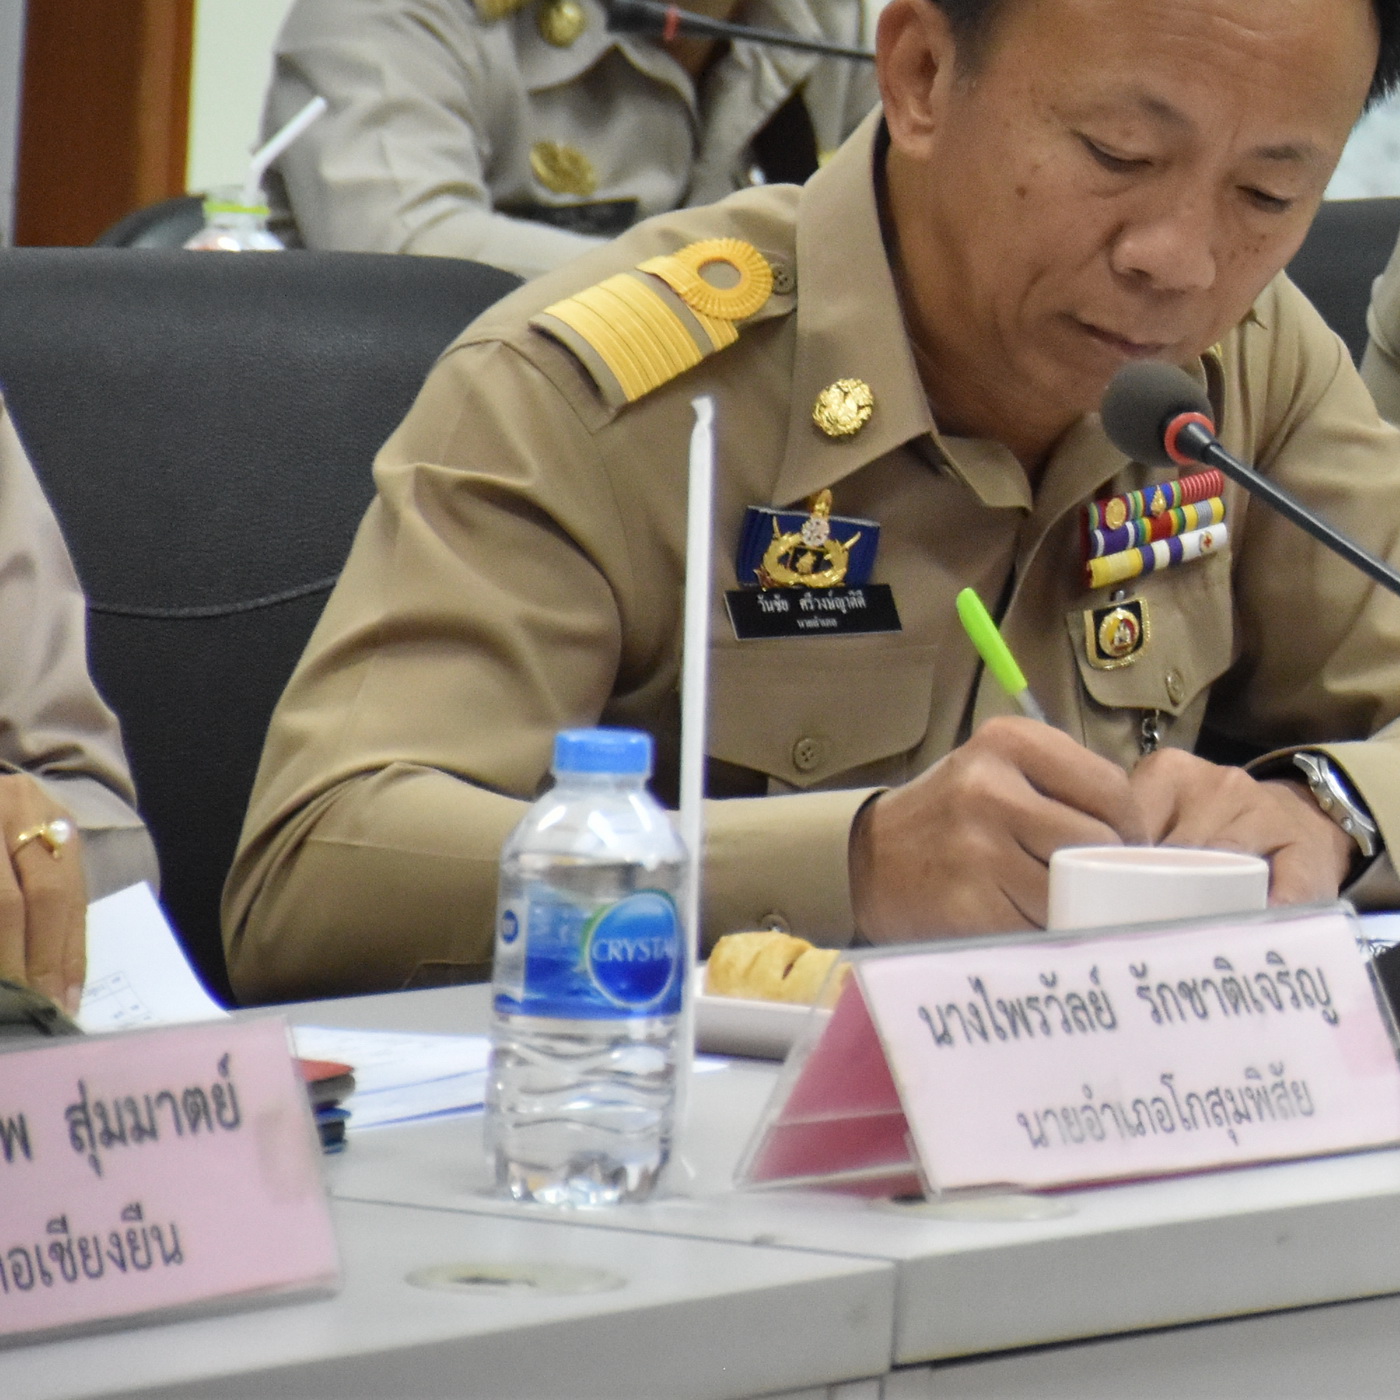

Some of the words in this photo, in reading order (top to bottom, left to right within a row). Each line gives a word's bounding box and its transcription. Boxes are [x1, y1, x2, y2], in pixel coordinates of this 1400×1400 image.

[918, 964, 1118, 1046] นางไพรวัลย์
[1129, 950, 1339, 1026] รักชาติเจริญ
[1017, 1061, 1315, 1148] นายอำเภอโกสุมพิสัย
[0, 1202, 184, 1294] อเชียงยืน
